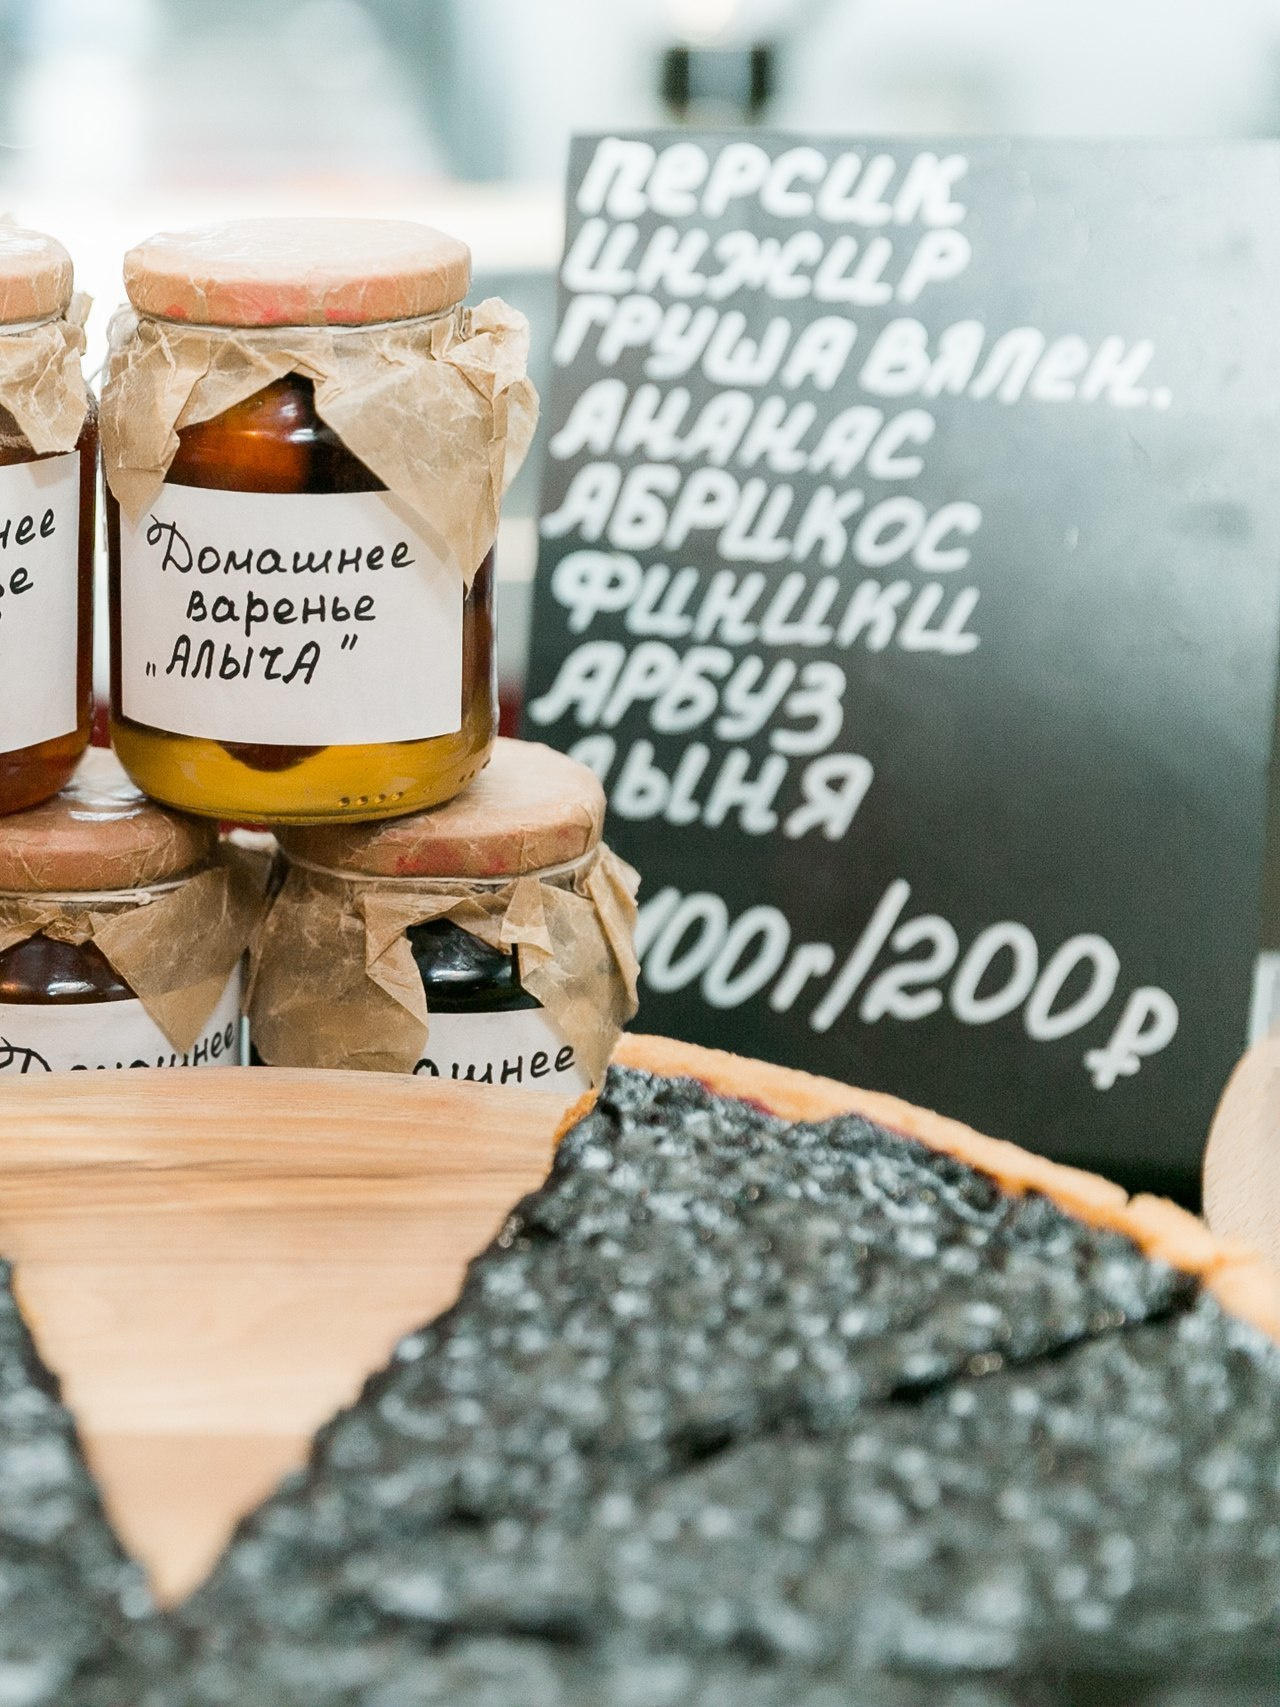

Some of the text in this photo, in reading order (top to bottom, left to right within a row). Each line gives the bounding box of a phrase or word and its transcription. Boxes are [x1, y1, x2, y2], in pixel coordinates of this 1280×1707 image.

[552, 292, 859, 391] ГРУША
[547, 378, 936, 480] АНАНАС
[147, 514, 415, 574] Домашнее
[539, 461, 983, 573] АБРИКОС
[186, 590, 376, 637] варенье
[549, 550, 982, 654] ФИНИКИ
[529, 641, 846, 756] АРБУЗ
